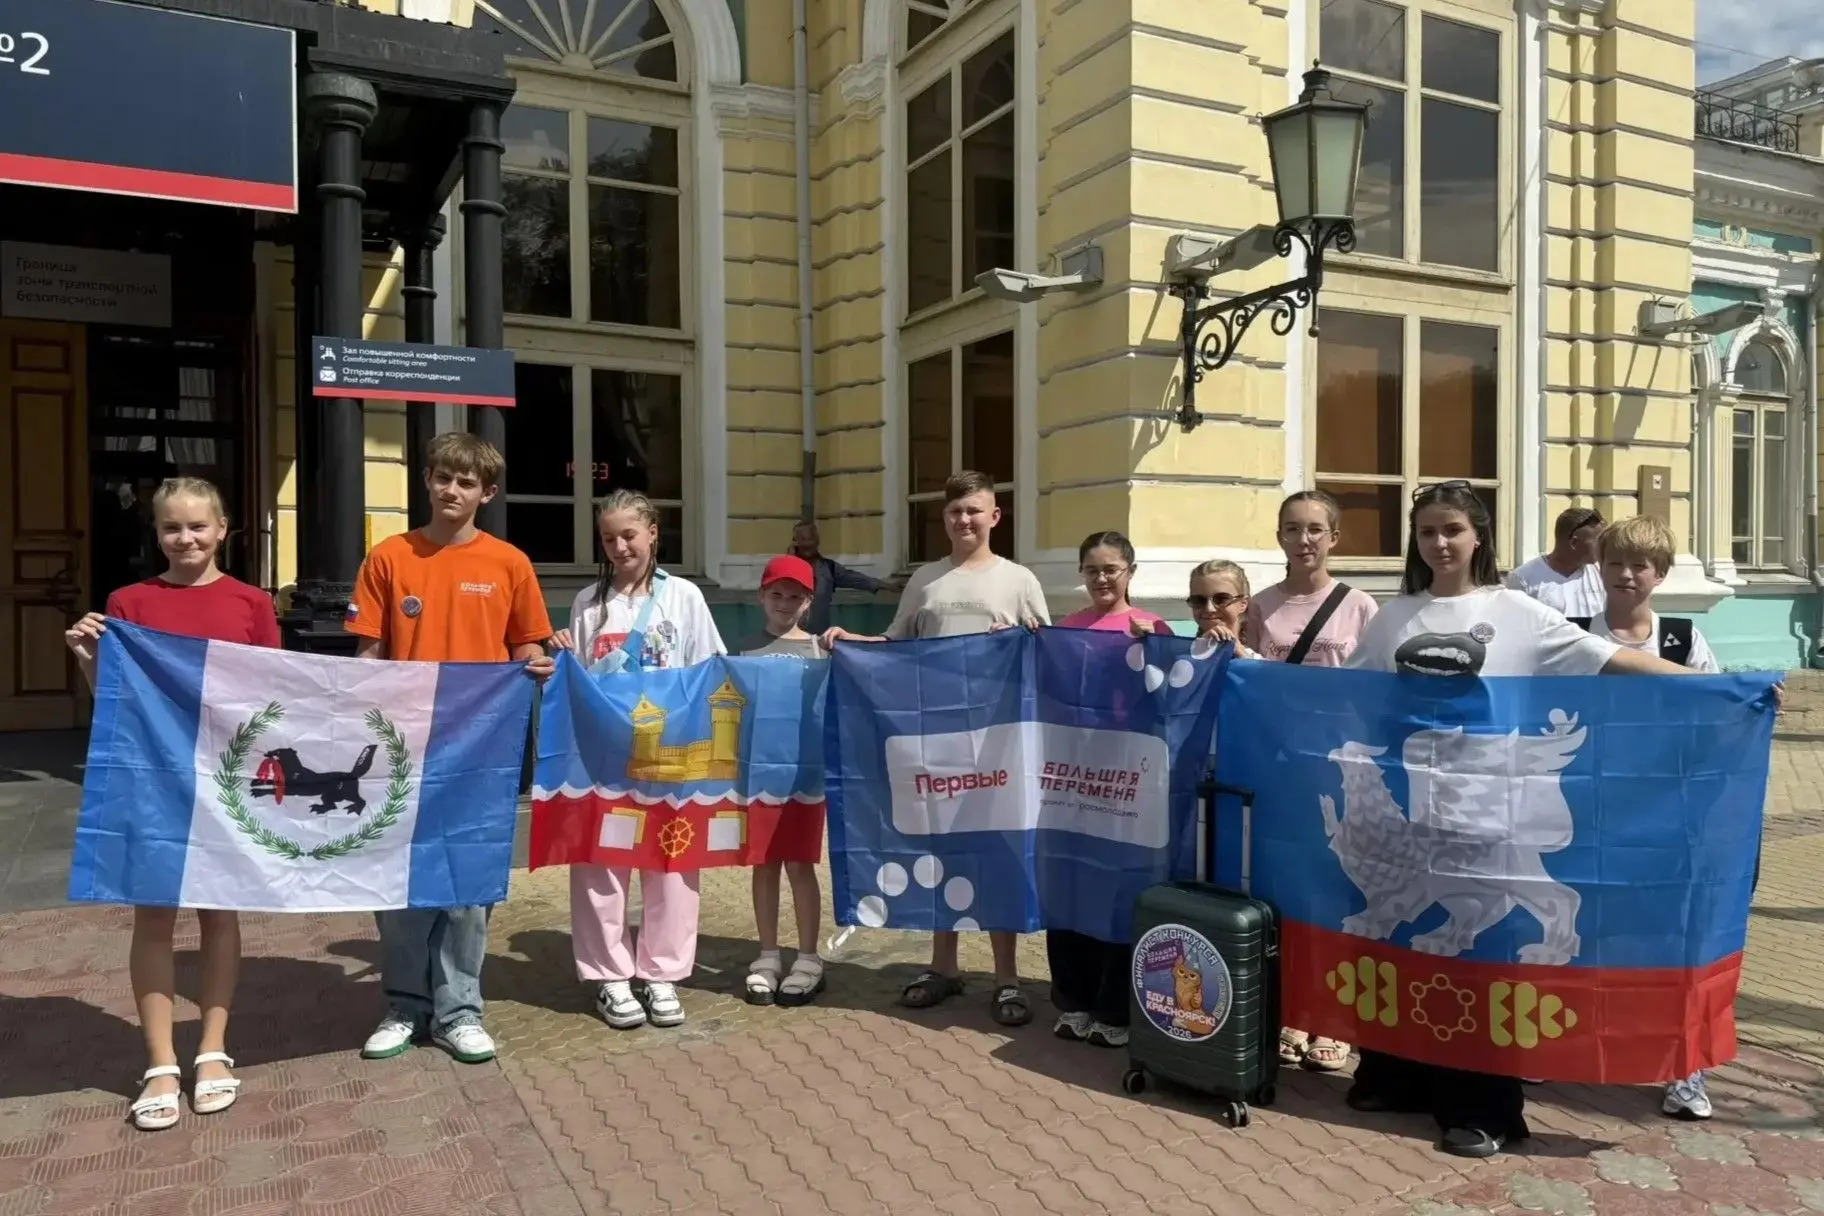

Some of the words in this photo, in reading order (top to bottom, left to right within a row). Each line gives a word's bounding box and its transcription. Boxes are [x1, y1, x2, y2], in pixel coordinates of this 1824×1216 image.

[15, 257, 77, 273] Граница
[342, 346, 358, 355] Зал
[359, 349, 414, 358] повышенной
[416, 352, 476, 363] комфортности
[342, 355, 387, 365] Comfortable
[342, 367, 384, 377] Отправка
[385, 371, 461, 382] корреспонденции
[359, 376, 380, 385] office
[1043, 761, 1139, 786] БОЛЬШАЯ
[915, 769, 1008, 799] Первые
[1040, 777, 1136, 802] ПЕРЕМЕНА
[1135, 932, 1160, 989] ФИНАЛИСТ
[1162, 929, 1218, 966] КОНКУРСА
[1146, 990, 1165, 1003] ЕДУ
[1167, 995, 1174, 1006] В
[1146, 1000, 1216, 1027] КРАСНОЯРСК!
